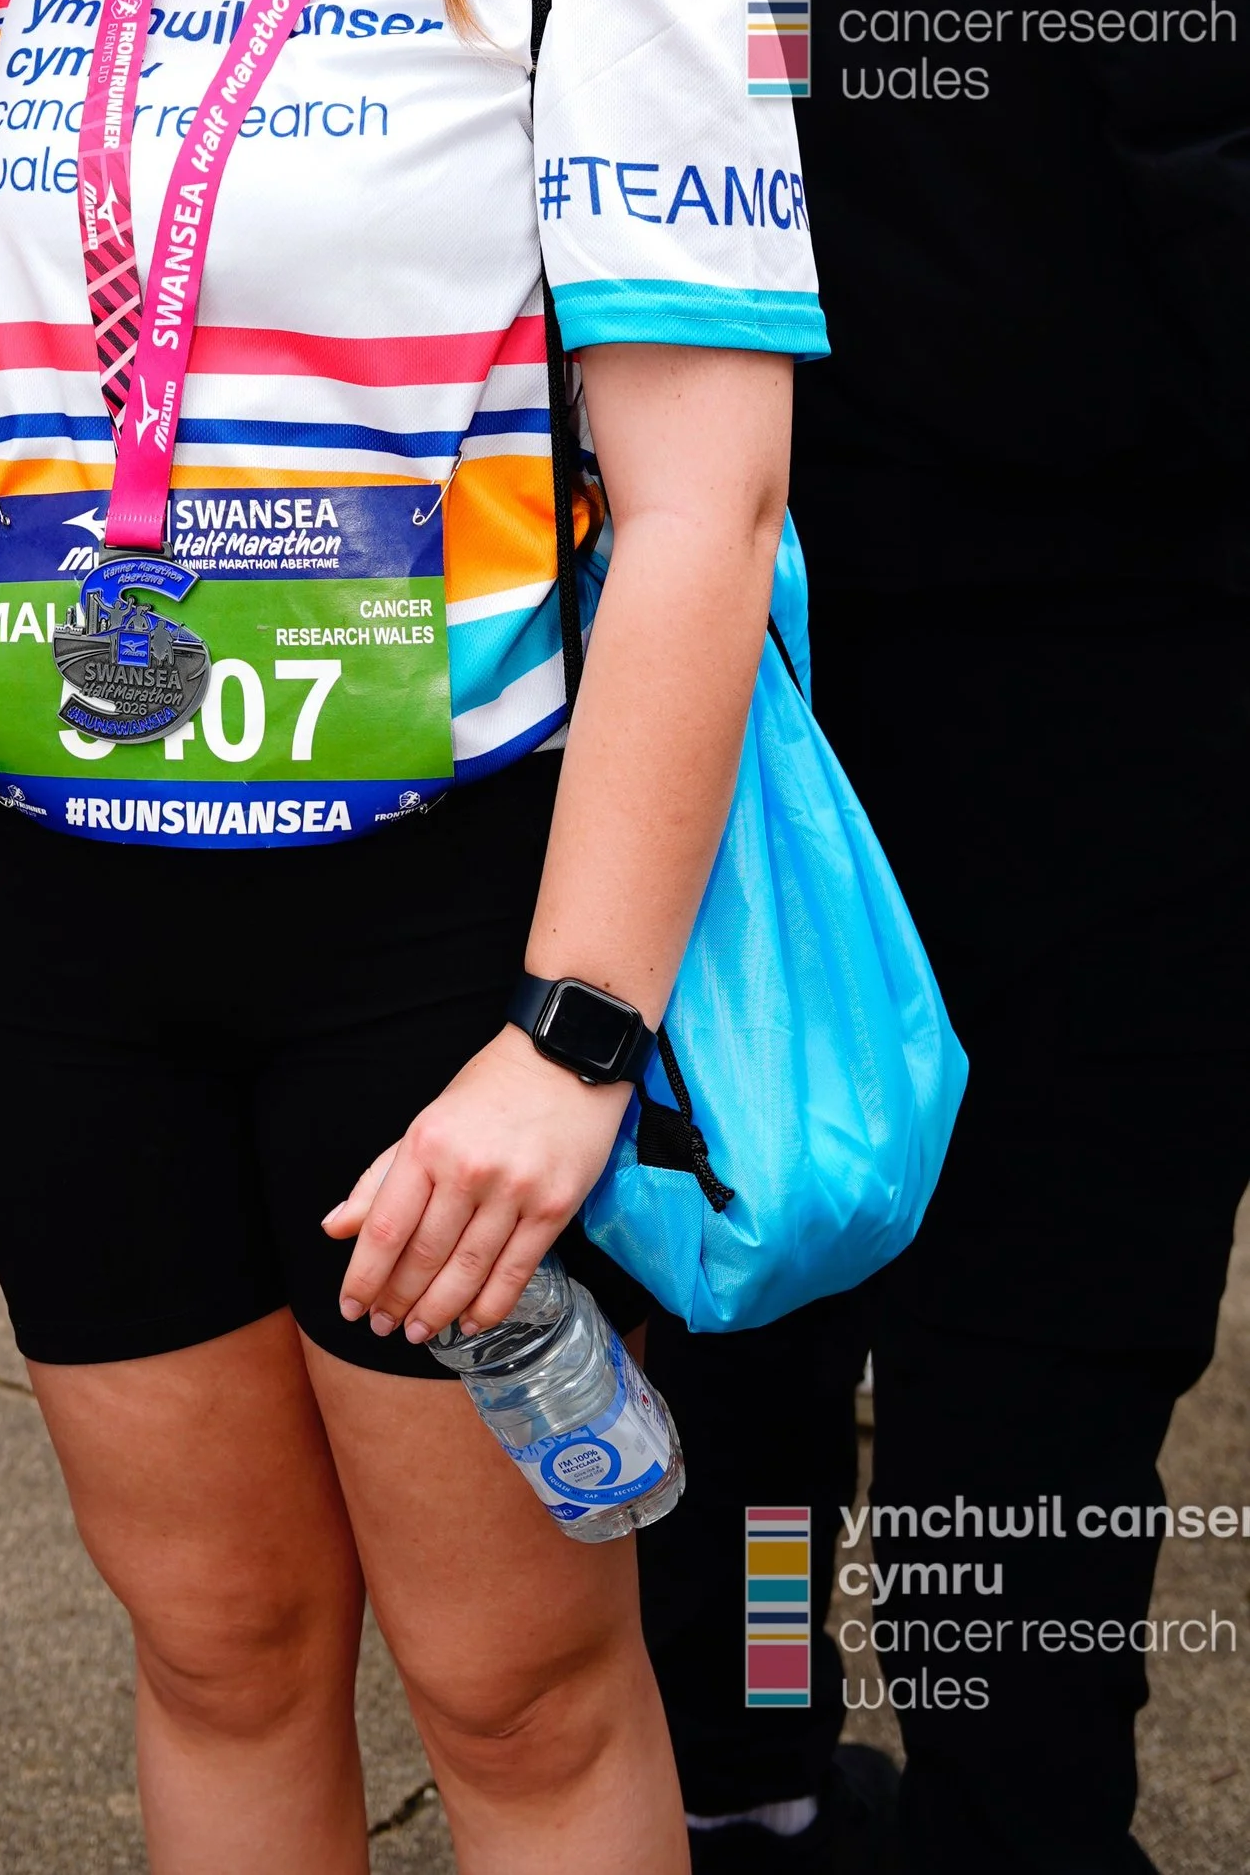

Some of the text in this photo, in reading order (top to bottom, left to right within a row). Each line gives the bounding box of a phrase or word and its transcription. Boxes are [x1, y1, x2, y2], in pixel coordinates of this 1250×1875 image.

[97, 23, 118, 84] EVENTS LTD
[103, 22, 137, 150] FRONTRUNNER
[155, 95, 389, 138] reearch
[152, 182, 208, 351] SWANSEA
[191, 104, 229, 173] Half
[175, 498, 339, 530] SWANSEA
[102, 562, 184, 583] Hanner Marathon
[219, 558, 278, 570] MARATHON
[280, 558, 340, 570] ABERTAWE
[359, 599, 433, 620] CANCER
[275, 625, 435, 647] RESEARCH WALES
[84, 662, 182, 690] SWANSEA
[66, 704, 178, 736] #RUNSWANSEA
[115, 700, 148, 716] 2026
[65, 797, 352, 835] #RUNSWANSEA
[558, 1449, 598, 1471] I'M 100%
[562, 1456, 602, 1475] RECYCLABLE
[548, 1476, 571, 1493] SQUASH
[613, 1484, 642, 1497] RECYCLE
